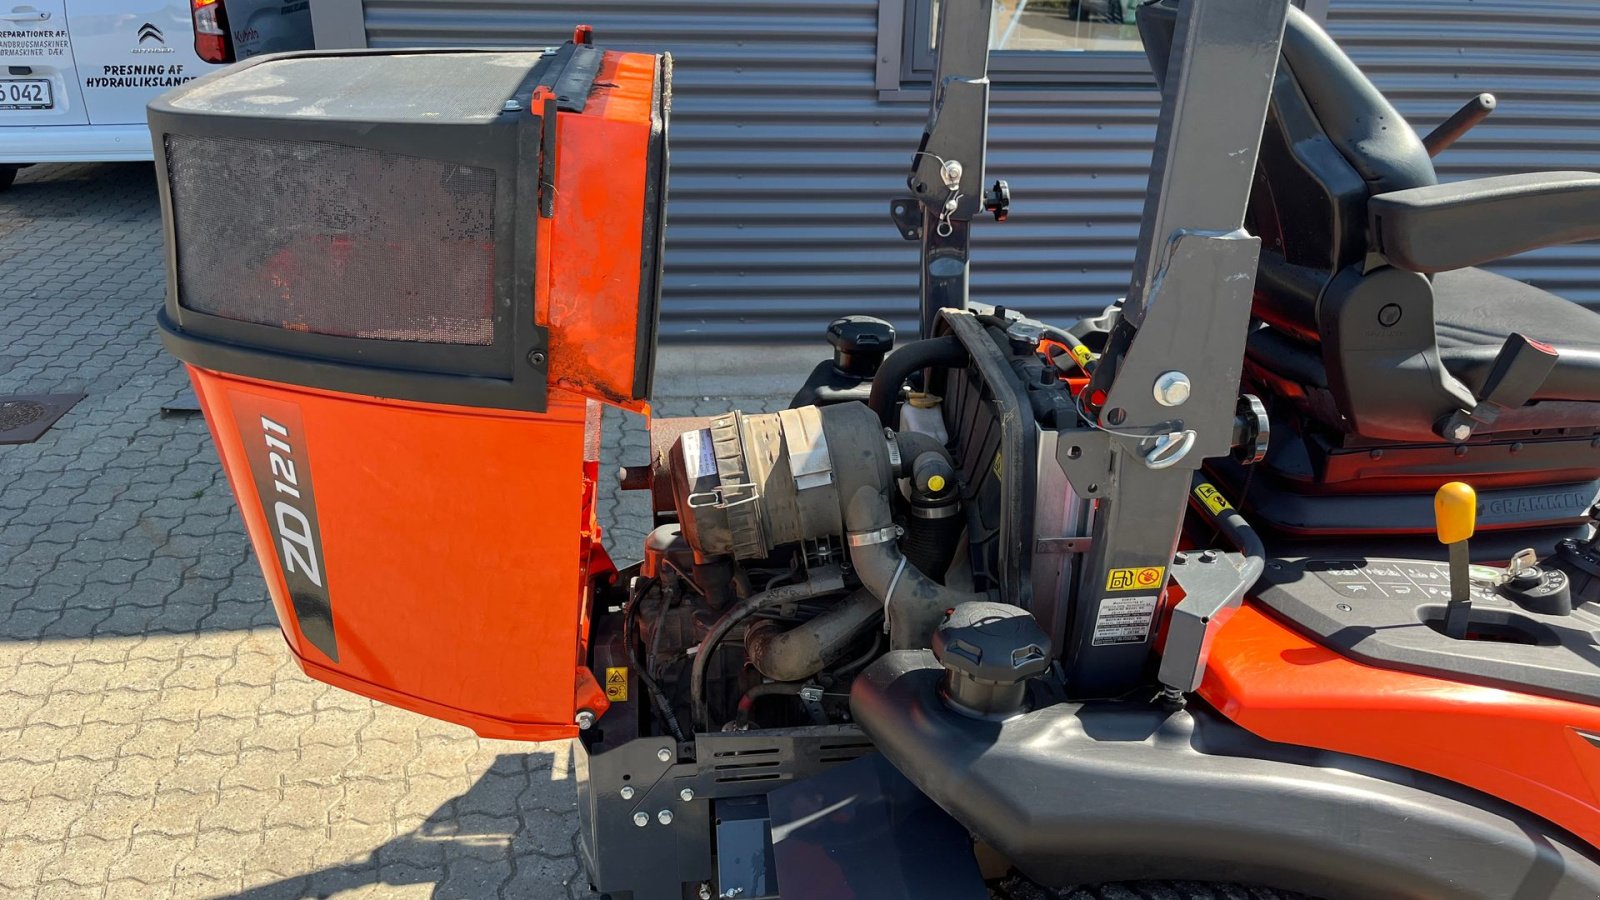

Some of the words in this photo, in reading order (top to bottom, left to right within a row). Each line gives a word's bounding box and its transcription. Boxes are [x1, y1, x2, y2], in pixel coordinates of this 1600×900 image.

[103, 65, 165, 75] PRESNING
[168, 65, 183, 75] AF
[10, 84, 43, 102] 042
[261, 416, 300, 498] 1211
[1490, 493, 1585, 514] GRAMMER
[274, 501, 322, 587] ZD
